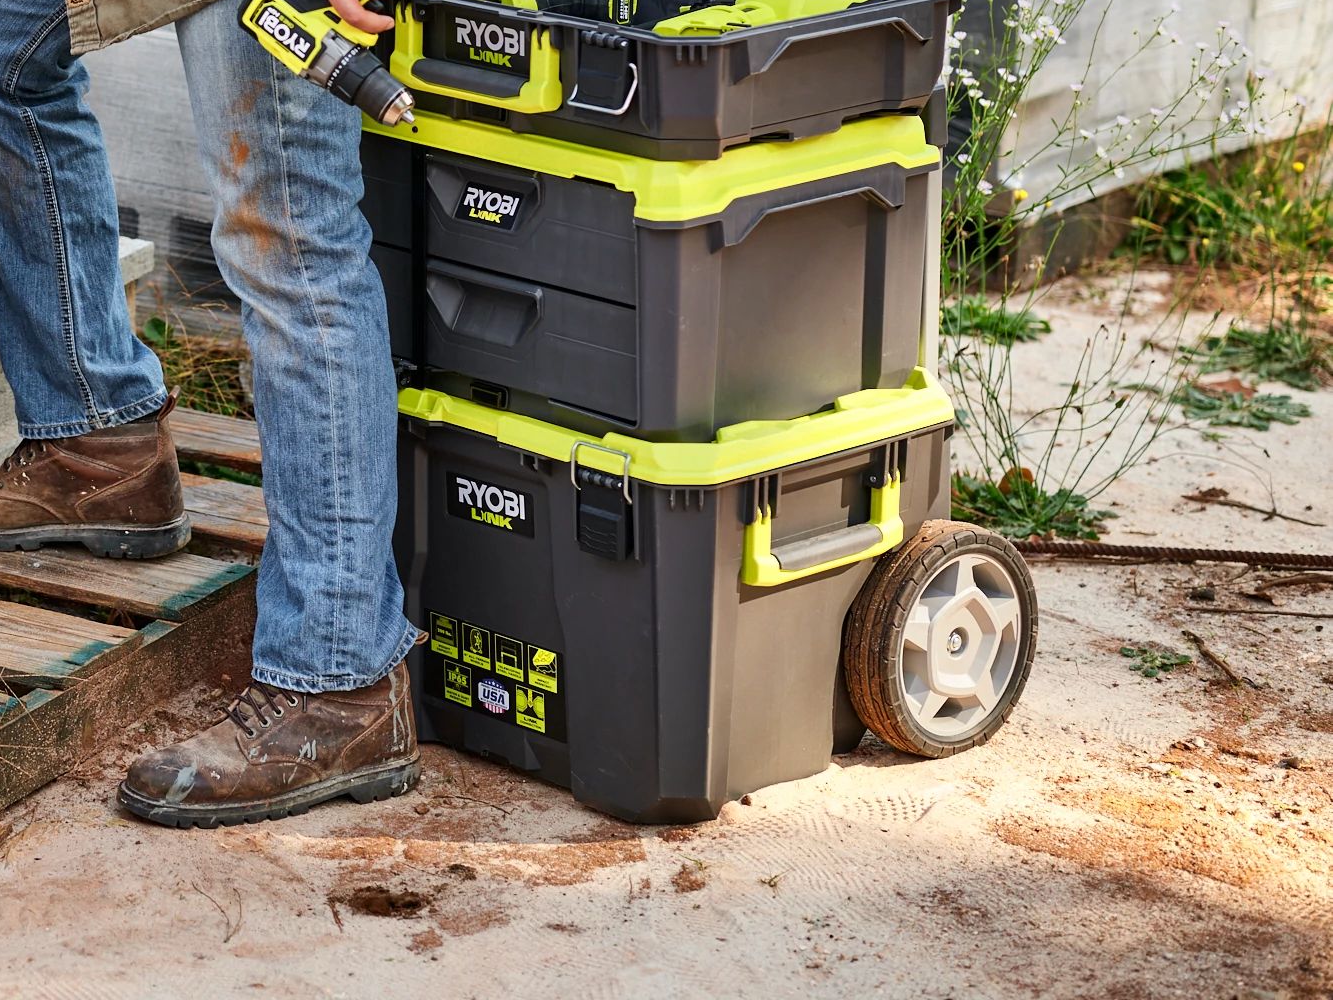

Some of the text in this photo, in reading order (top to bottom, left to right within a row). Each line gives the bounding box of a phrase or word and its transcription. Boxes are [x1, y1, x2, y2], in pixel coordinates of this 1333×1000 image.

[258, 10, 311, 59] RYOBI
[455, 16, 525, 57] RYOBI
[469, 47, 512, 68] LINK
[463, 186, 520, 217] RYOBI
[469, 208, 503, 224] LINK
[456, 476, 526, 521] RYOBI
[471, 507, 513, 530] LINK
[448, 671, 467, 686] IP65
[482, 688, 505, 706] USA
